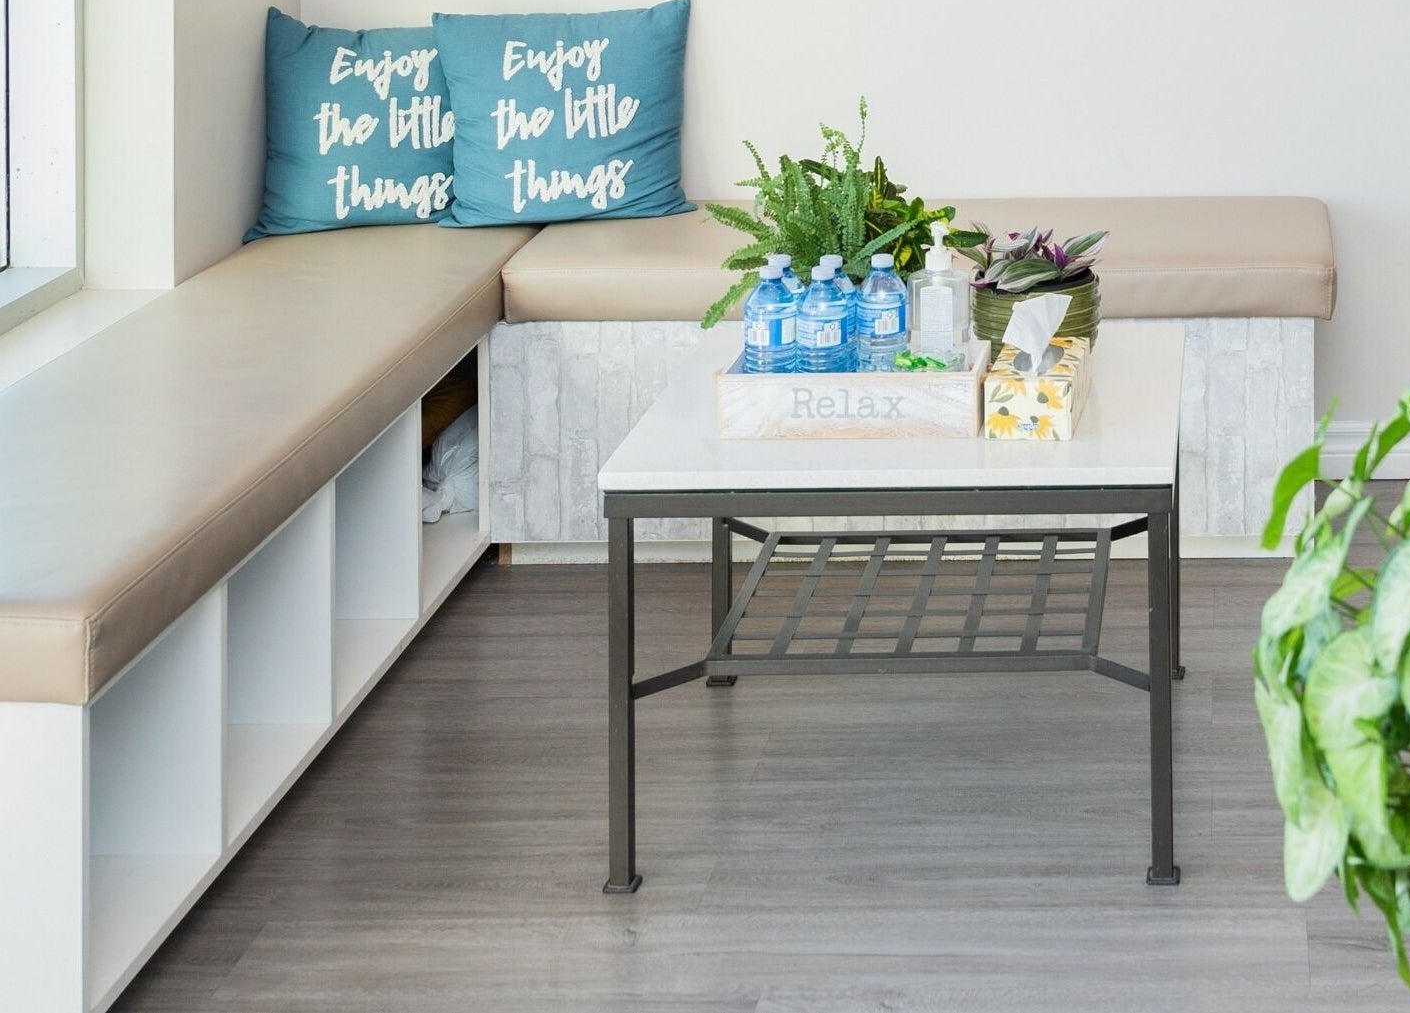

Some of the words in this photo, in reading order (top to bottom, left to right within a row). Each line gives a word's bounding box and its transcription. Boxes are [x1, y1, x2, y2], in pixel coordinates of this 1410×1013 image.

[329, 45, 437, 101] Enjoy
[502, 37, 610, 92] Enjoy
[313, 101, 379, 155] the
[490, 98, 555, 150] the
[564, 83, 640, 140] little
[505, 158, 634, 213] things
[790, 387, 906, 419] Relax
